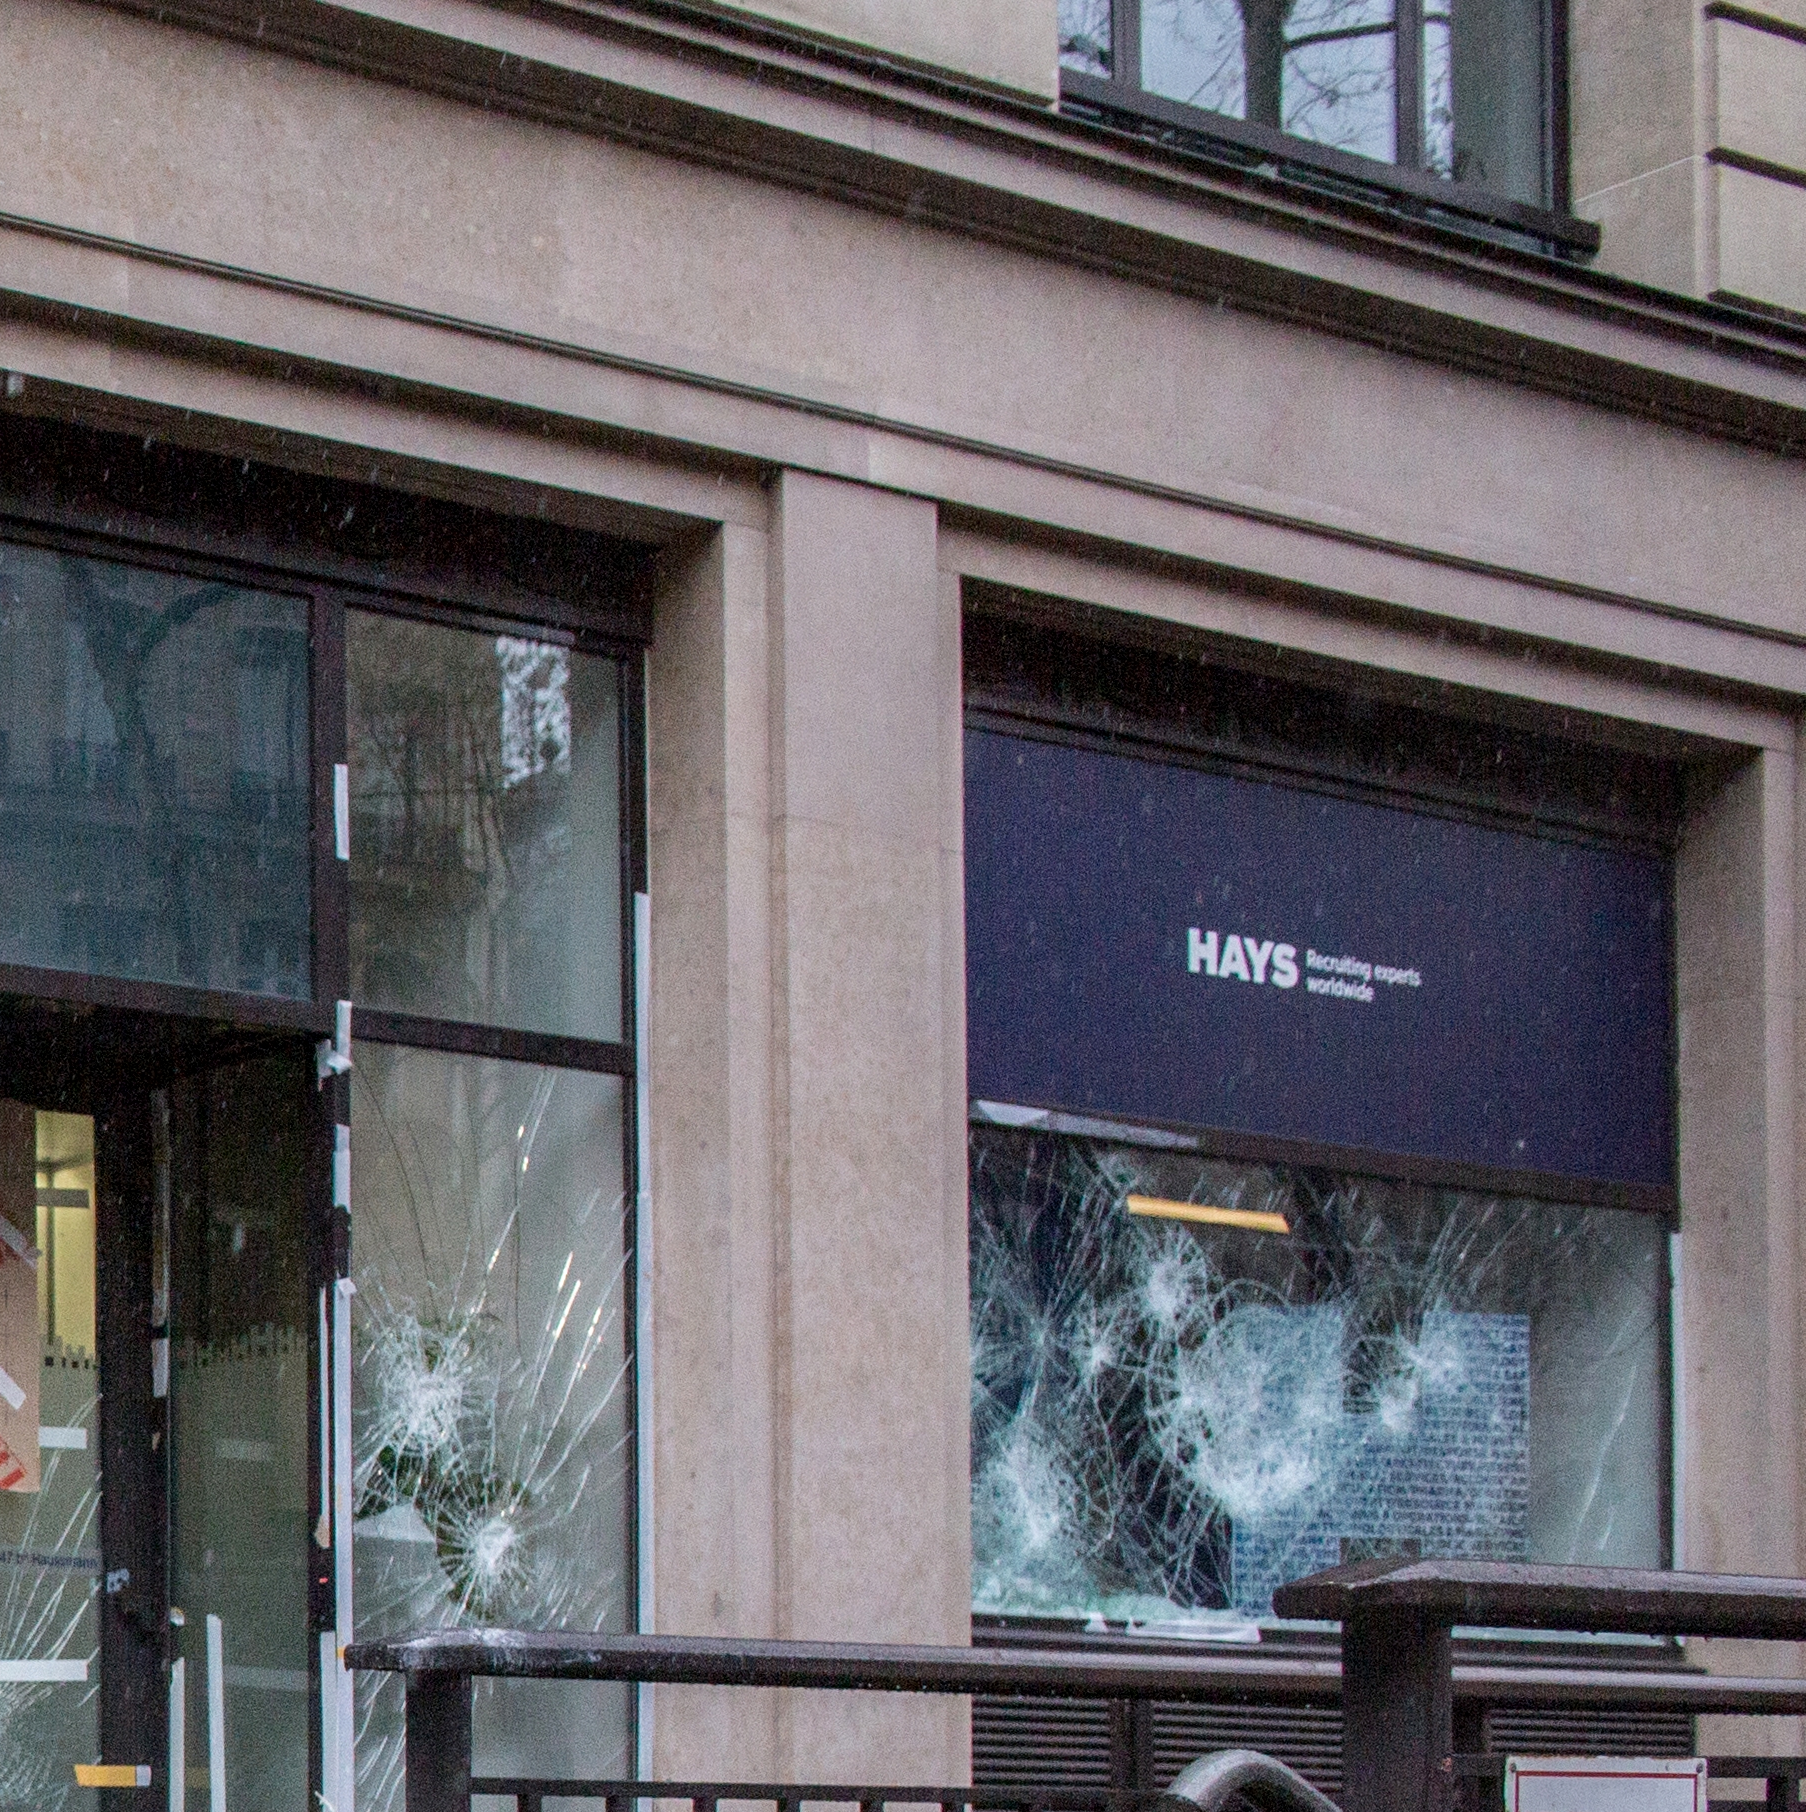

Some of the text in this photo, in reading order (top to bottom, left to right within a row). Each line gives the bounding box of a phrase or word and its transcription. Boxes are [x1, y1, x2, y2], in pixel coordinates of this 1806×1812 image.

[1188, 927, 1299, 989] HAYS
[1306, 949, 1422, 988] Recruiting experts
[1306, 976, 1375, 1003] worldwide
